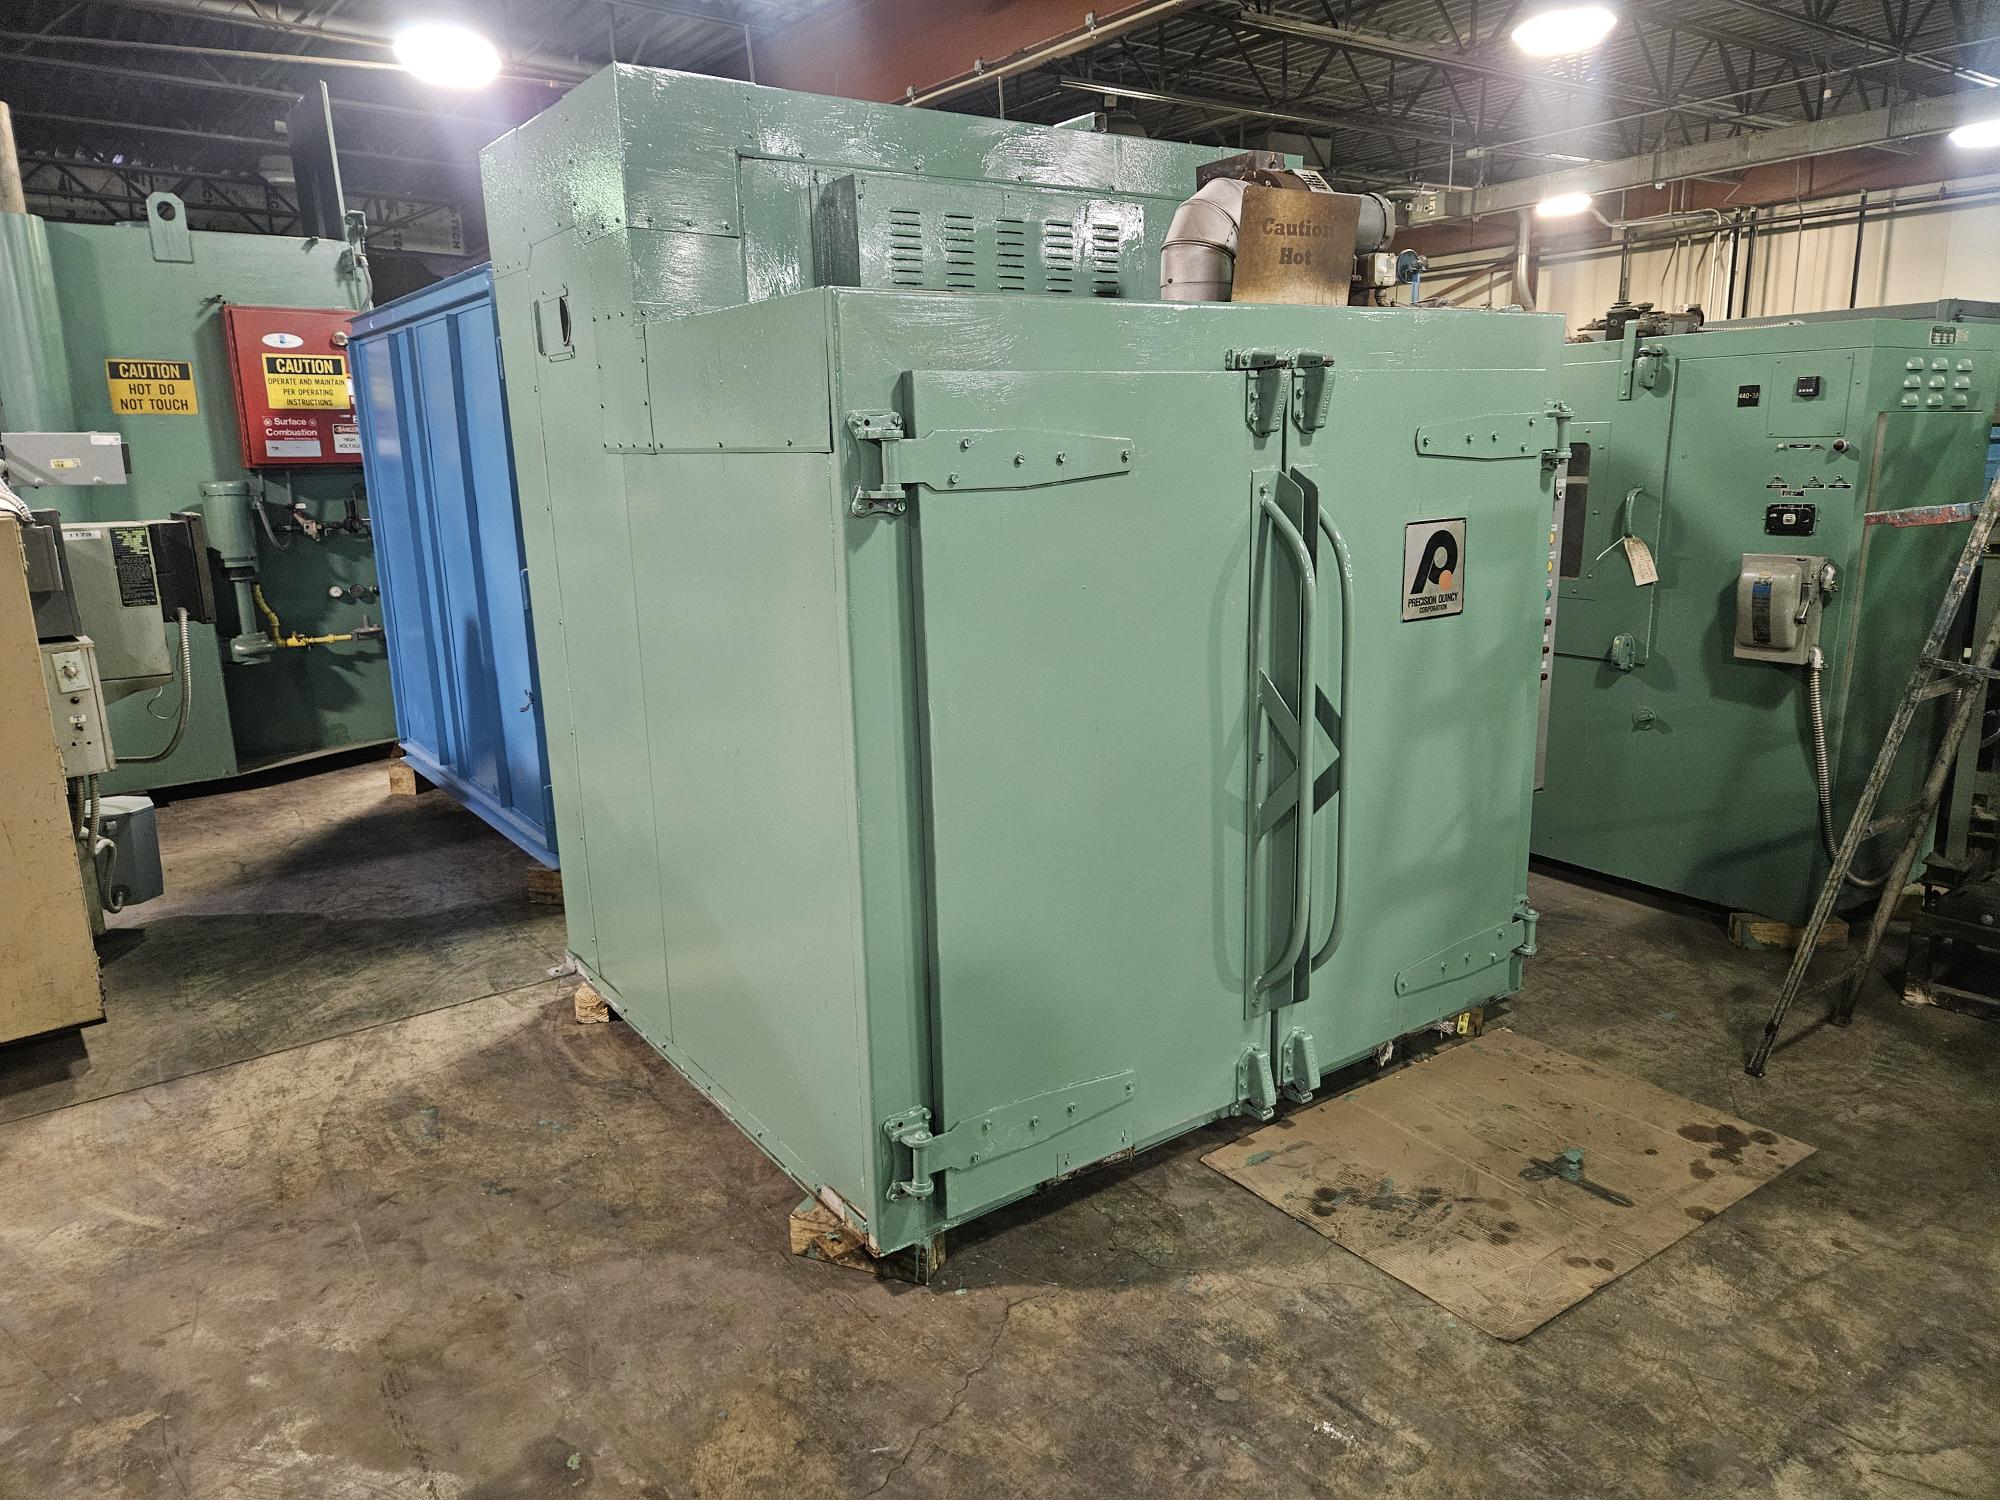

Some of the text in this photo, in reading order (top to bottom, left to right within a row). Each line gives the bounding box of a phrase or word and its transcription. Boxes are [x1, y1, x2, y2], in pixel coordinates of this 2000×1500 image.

[1262, 218, 1333, 238] Caution
[1279, 247, 1312, 266] Hot
[119, 363, 181, 379] CAUTION
[276, 359, 334, 374] CAUTION
[267, 377, 297, 386] OPERATE
[299, 378, 313, 386] AND
[128, 383, 175, 395] HOT DO
[283, 388, 296, 396] PER
[120, 398, 189, 411] NOT TOUCH
[286, 398, 334, 407] INSTRUCTIONS
[273, 417, 307, 426] Surface
[265, 428, 318, 437] Combustion
[1408, 592, 1458, 608] PRECISION QUINCY
[1419, 604, 1447, 613] CORPORATION
